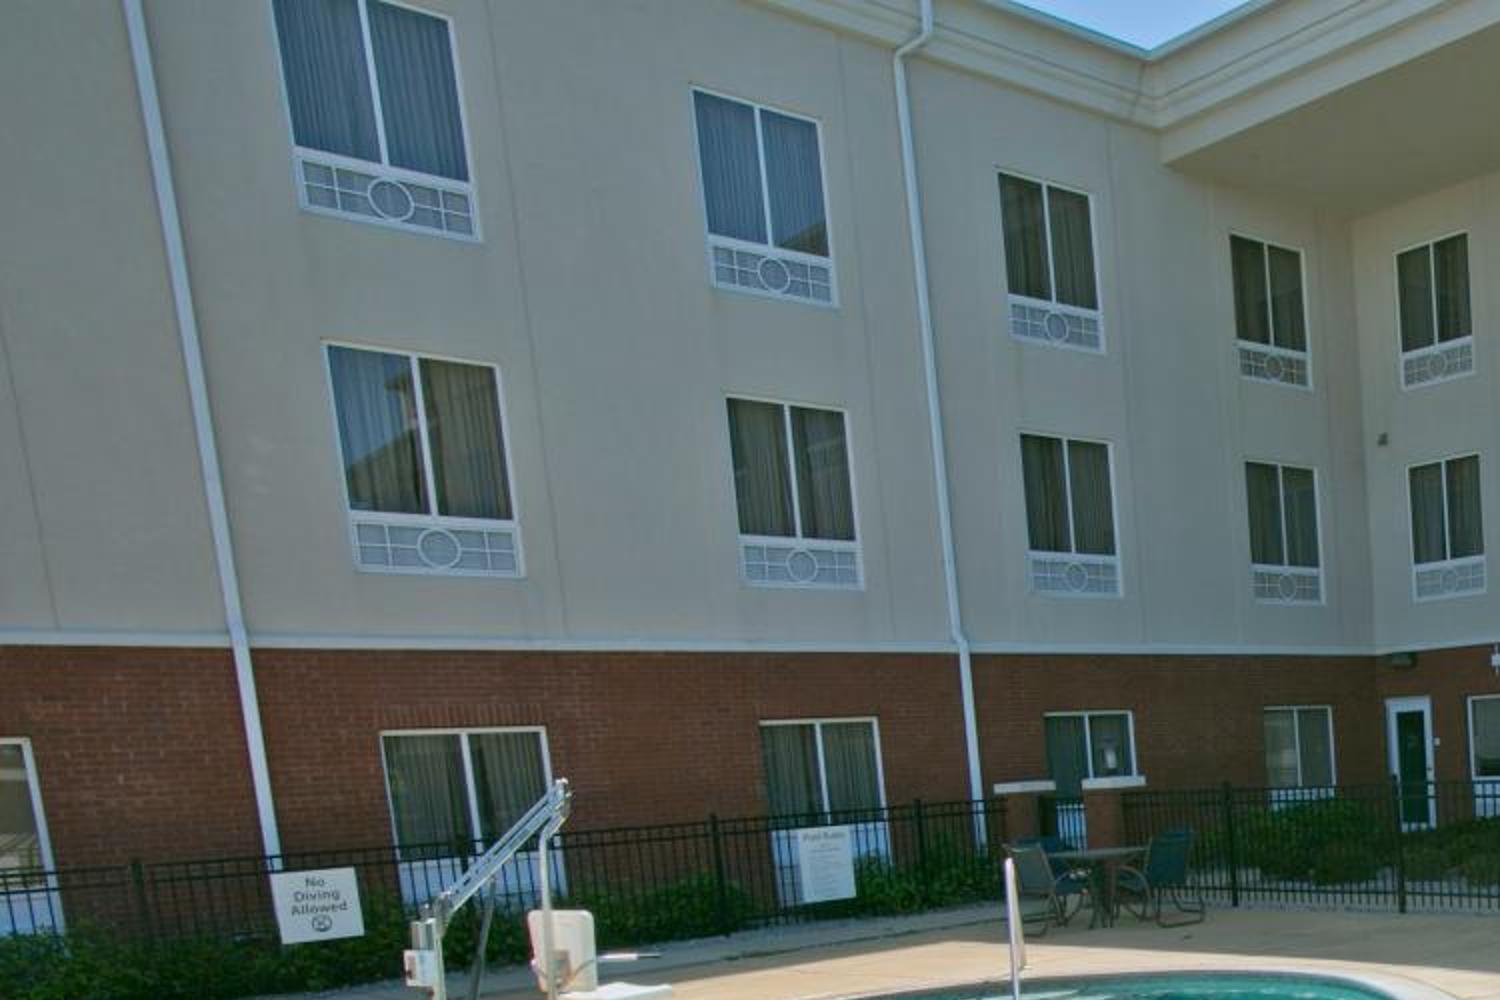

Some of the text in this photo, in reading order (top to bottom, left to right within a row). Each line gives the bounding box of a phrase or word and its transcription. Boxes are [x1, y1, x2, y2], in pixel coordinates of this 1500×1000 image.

[305, 877, 325, 887] No
[294, 891, 340, 902] Diving
[291, 901, 348, 915] Allowed
